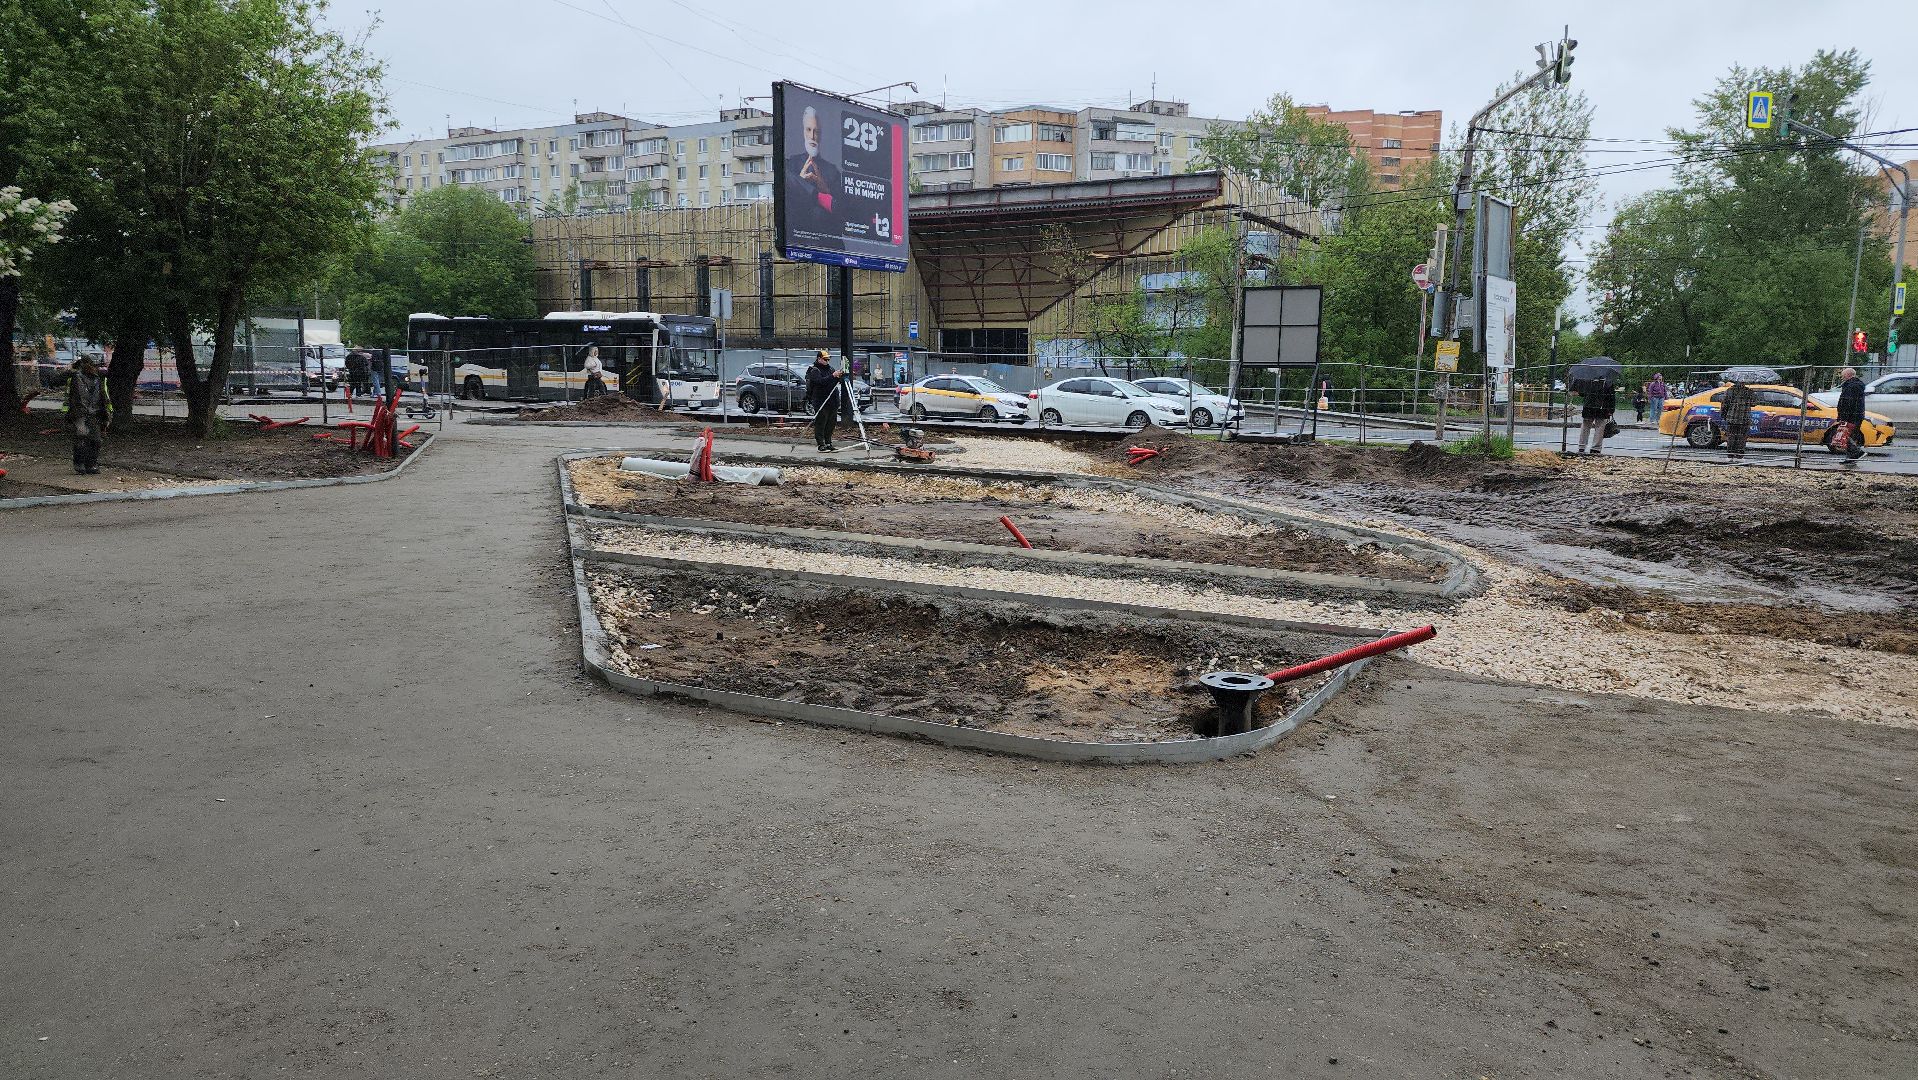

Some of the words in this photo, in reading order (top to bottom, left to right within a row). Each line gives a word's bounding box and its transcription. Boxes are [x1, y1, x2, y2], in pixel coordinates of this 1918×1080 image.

[843, 117, 884, 152] 28%
[844, 177, 855, 186] НА
[855, 187, 861, 196] И
[861, 188, 885, 200] МИНУТ
